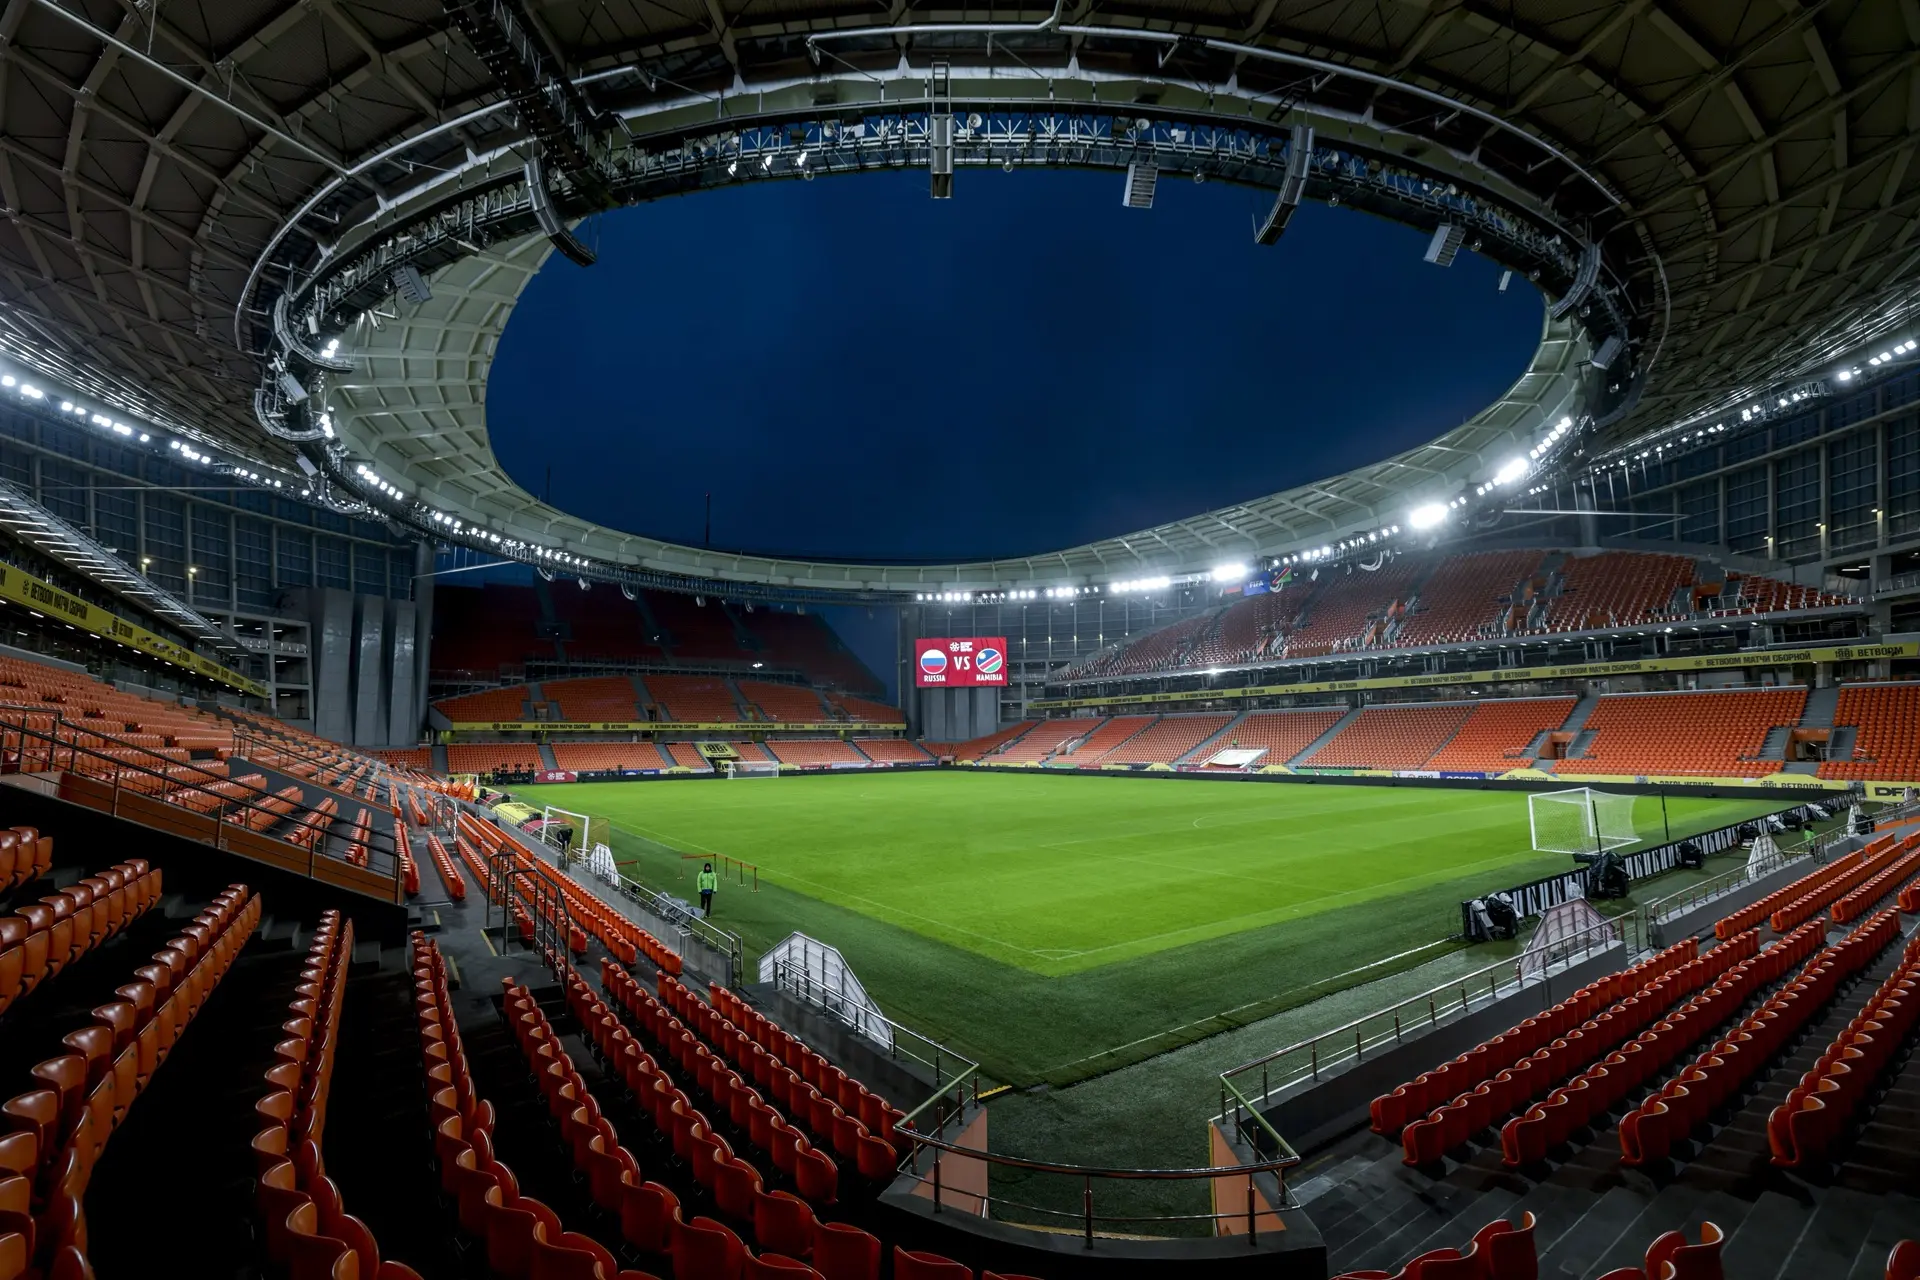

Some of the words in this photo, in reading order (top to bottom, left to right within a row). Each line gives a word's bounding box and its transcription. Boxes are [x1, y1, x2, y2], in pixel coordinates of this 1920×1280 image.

[1249, 580, 1264, 588] FIFA
[954, 656, 970, 670] VS
[1706, 657, 1740, 666] BETBOOM
[1743, 655, 1771, 664] МАТЧИ
[1772, 651, 1811, 662] СБОРНОЙ
